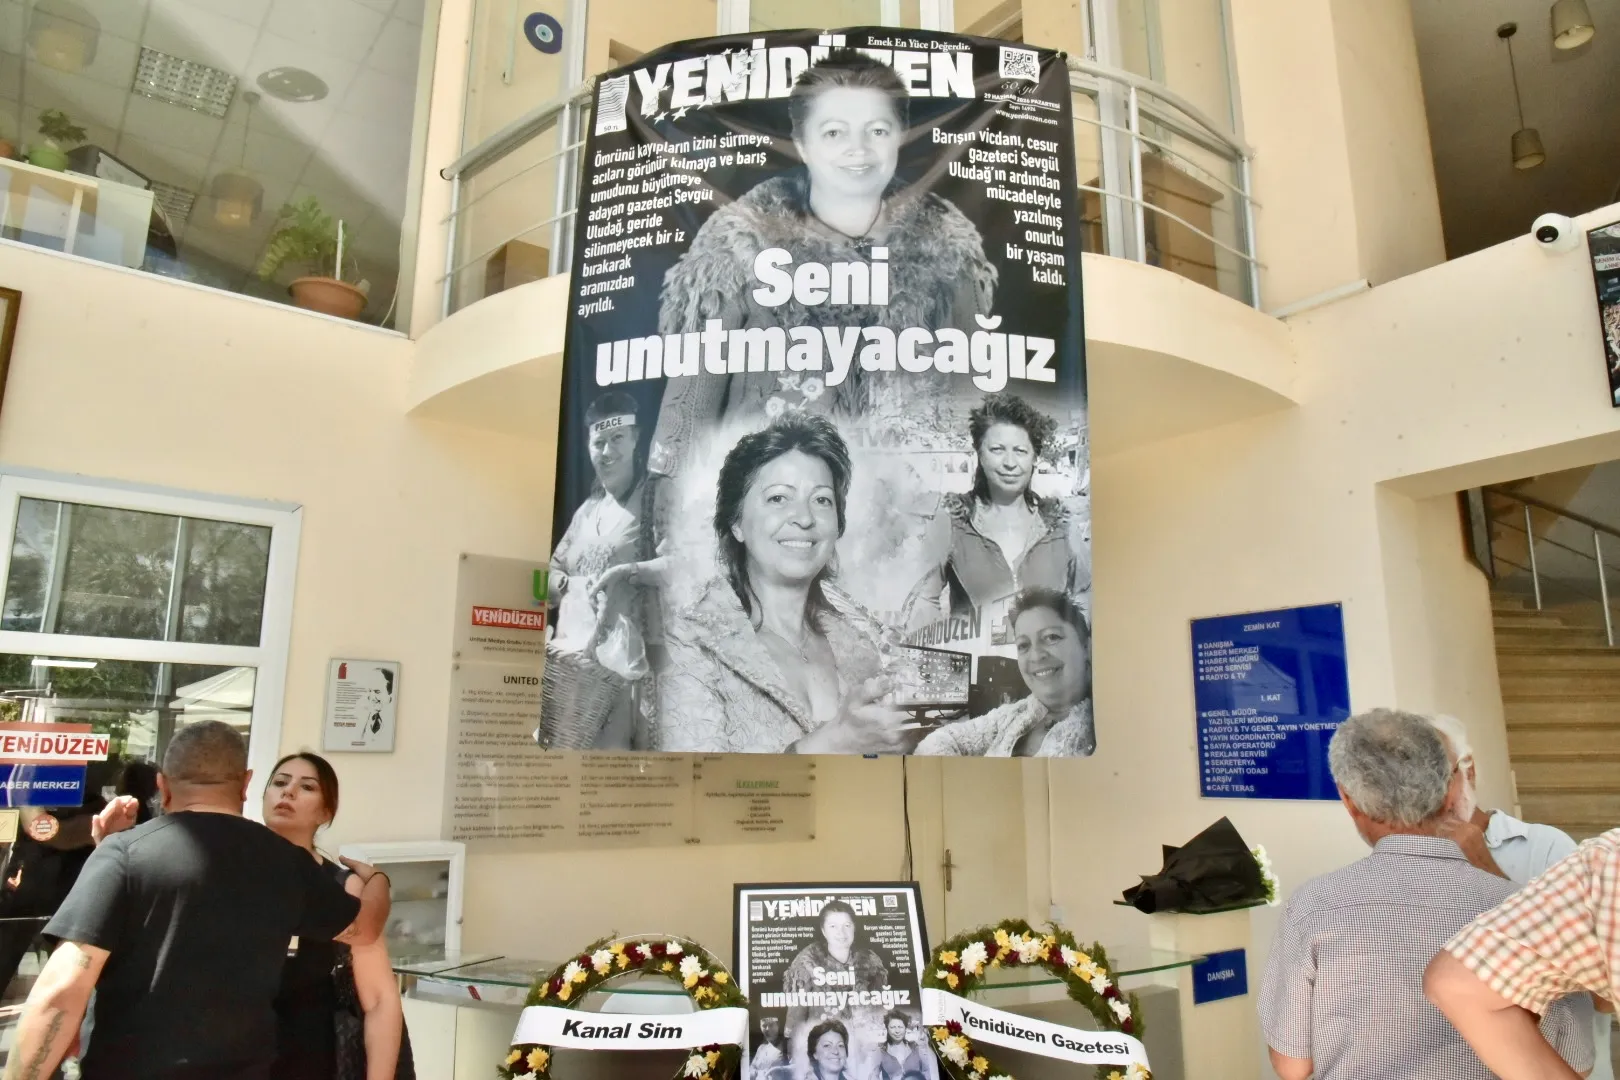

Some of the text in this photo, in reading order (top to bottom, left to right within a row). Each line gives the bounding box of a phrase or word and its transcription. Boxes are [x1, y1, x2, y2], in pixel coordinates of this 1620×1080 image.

[867, 36, 971, 53] Emek En Yüce Değerdir.
[633, 35, 976, 116] YENİDEN
[995, 109, 1058, 126] www.yeniduzen.com
[594, 132, 773, 167] Ömrünü kayıpların izini sürmeye,
[932, 127, 1059, 153] Barışın vicdanı, cesur
[592, 151, 767, 185] acıları görünür kılmaya ve barış
[968, 148, 1059, 173] gazeteci Sevgül
[590, 173, 701, 203] umudunu büyütmeye
[1009, 170, 1061, 191] ardından
[588, 189, 713, 221] adayan gazeteci Sevgül
[986, 185, 1062, 210] mücadeleyle
[586, 213, 663, 240] Uludağ, geride
[1014, 208, 1063, 230] yazılmış
[584, 229, 685, 259] silinmeyecek bir iz
[1025, 228, 1064, 247] onurlu
[1006, 242, 1065, 267] bir yaşam
[582, 255, 632, 278] bırakarak
[1032, 267, 1066, 286] kaldı.
[580, 275, 634, 297] aramızdan
[752, 246, 889, 308] Seni
[578, 296, 615, 318] ayrıldı.
[595, 313, 1056, 393] unutmayacağız
[595, 416, 623, 431] PEACE
[474, 609, 542, 627] YENİDÜZEN
[1243, 621, 1280, 632] ZEMİN KAT
[1203, 640, 1234, 649] DANIŞMA
[1204, 645, 1259, 657] HABER MERKEZİ
[1204, 654, 1259, 665] HABER MÜDÜRÜ
[1205, 663, 1252, 673] SPOR SERVİSİ
[503, 675, 539, 686] UNITED
[1223, 717, 1246, 726] İŞLERİ
[1247, 715, 1278, 724] MÜDÜRÜ
[1231, 708, 1257, 716] MÜDÜR
[1209, 741, 1276, 750] SAYFA OPERATÖRÜ
[1229, 732, 1286, 741] KOORDİNATÖRÜ
[1240, 749, 1267, 757] SERVİSİ
[33, 781, 80, 790] MERKEZİ
[1211, 775, 1232, 783] ARŞİV
[1211, 784, 1255, 792] CAFE TERAS
[763, 896, 877, 918] YENİDEN
[813, 966, 856, 986] Seni
[1207, 968, 1235, 982] DANIŞMA
[760, 984, 911, 1010] unutmayacağız
[561, 1018, 683, 1040] Kanal Sim
[959, 1007, 1130, 1055] Yenidüzen Gazetesi
